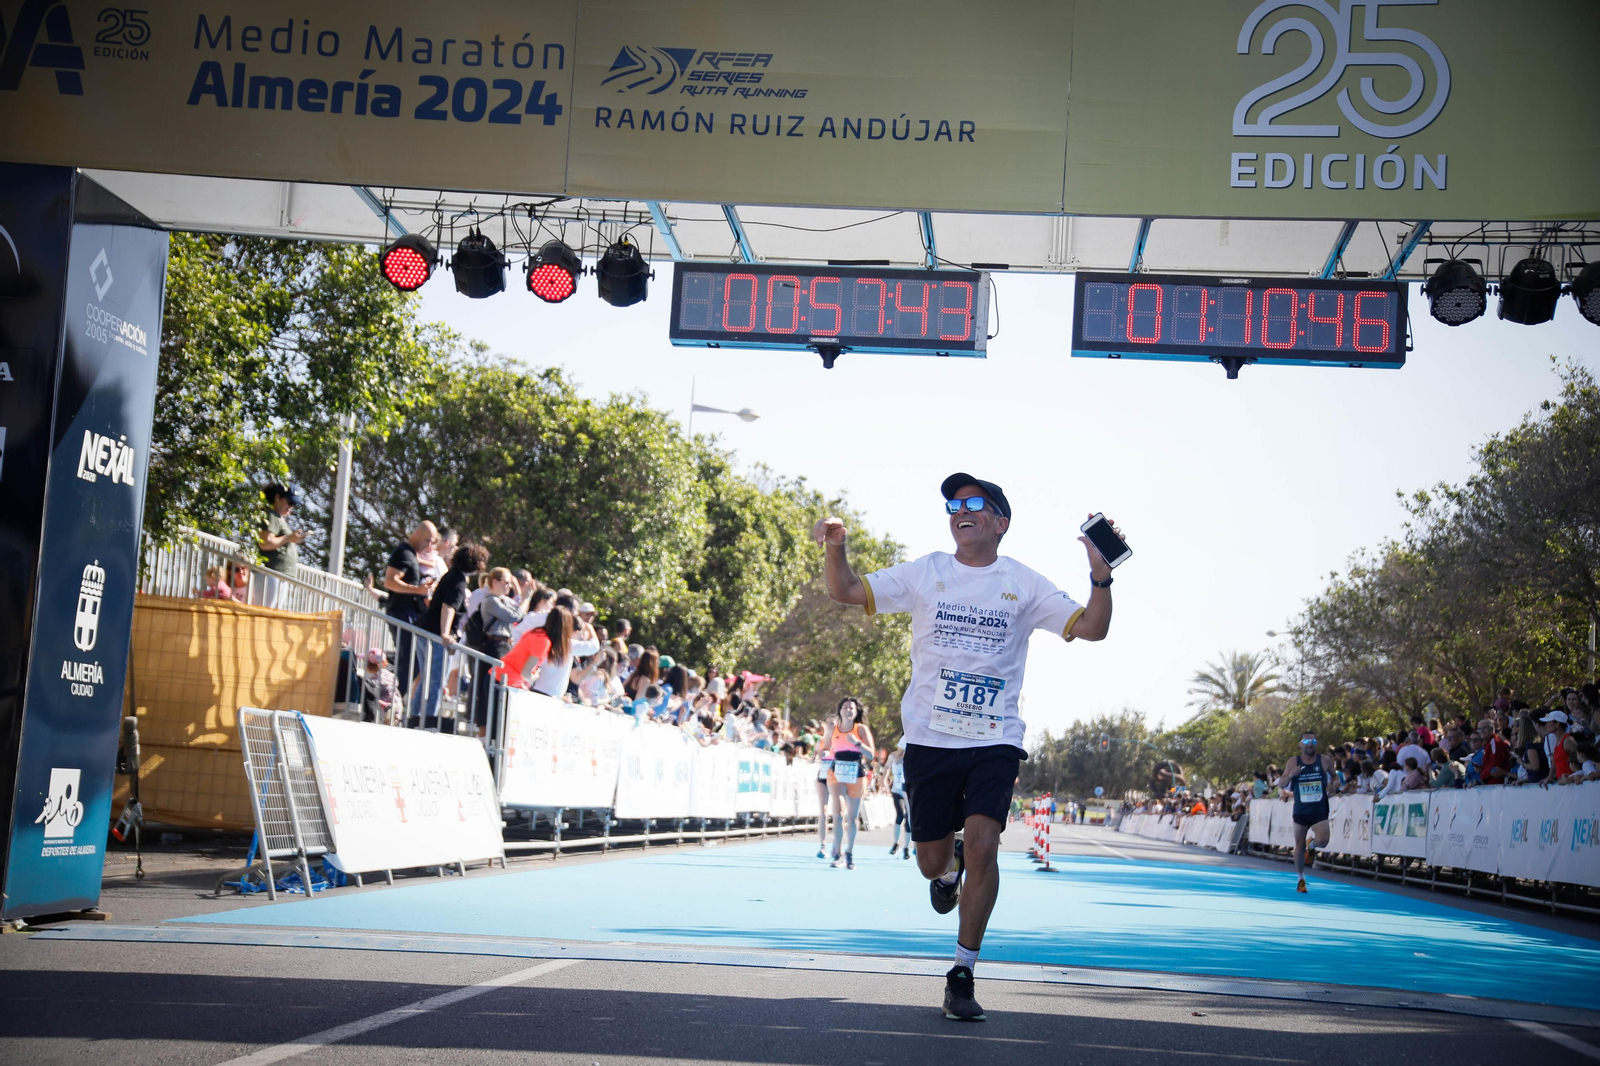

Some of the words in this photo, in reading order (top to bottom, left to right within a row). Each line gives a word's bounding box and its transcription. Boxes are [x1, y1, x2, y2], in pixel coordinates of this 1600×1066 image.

[95, 7, 151, 46] 25
[193, 13, 341, 57] Medio
[364, 25, 566, 70] Maratón
[94, 46, 149, 61] EDICIÓN
[696, 51, 774, 70] RFEA
[687, 70, 765, 85] SERIES
[1232, 0, 1452, 138] 25
[187, 61, 401, 118] Almería
[414, 74, 563, 127] 2024
[680, 85, 730, 97] RUTA
[733, 87, 809, 99] RUNNING
[594, 105, 714, 134] RAMÓN
[729, 113, 805, 138] RUIZ
[818, 113, 977, 143] ANDÚJAR
[1230, 144, 1448, 190] EDICIÓN
[85, 320, 108, 344] 2005
[86, 303, 147, 347] COOPERACIÓN
[937, 601, 966, 612] Medio
[969, 605, 1010, 618] Maratón
[935, 610, 977, 625] Almería
[979, 616, 1008, 629] 2024
[934, 623, 958, 632] RAMÓN
[977, 628, 1006, 637] ANDÚJAR
[61, 660, 104, 685] ALMERÍA
[71, 682, 94, 698] CIUDAD
[943, 681, 999, 707] 5187
[956, 702, 983, 711] EUSEBIO
[1302, 785, 1320, 793] 1712
[41, 846, 69, 857] DEPORTES
[69, 846, 77, 856] DE
